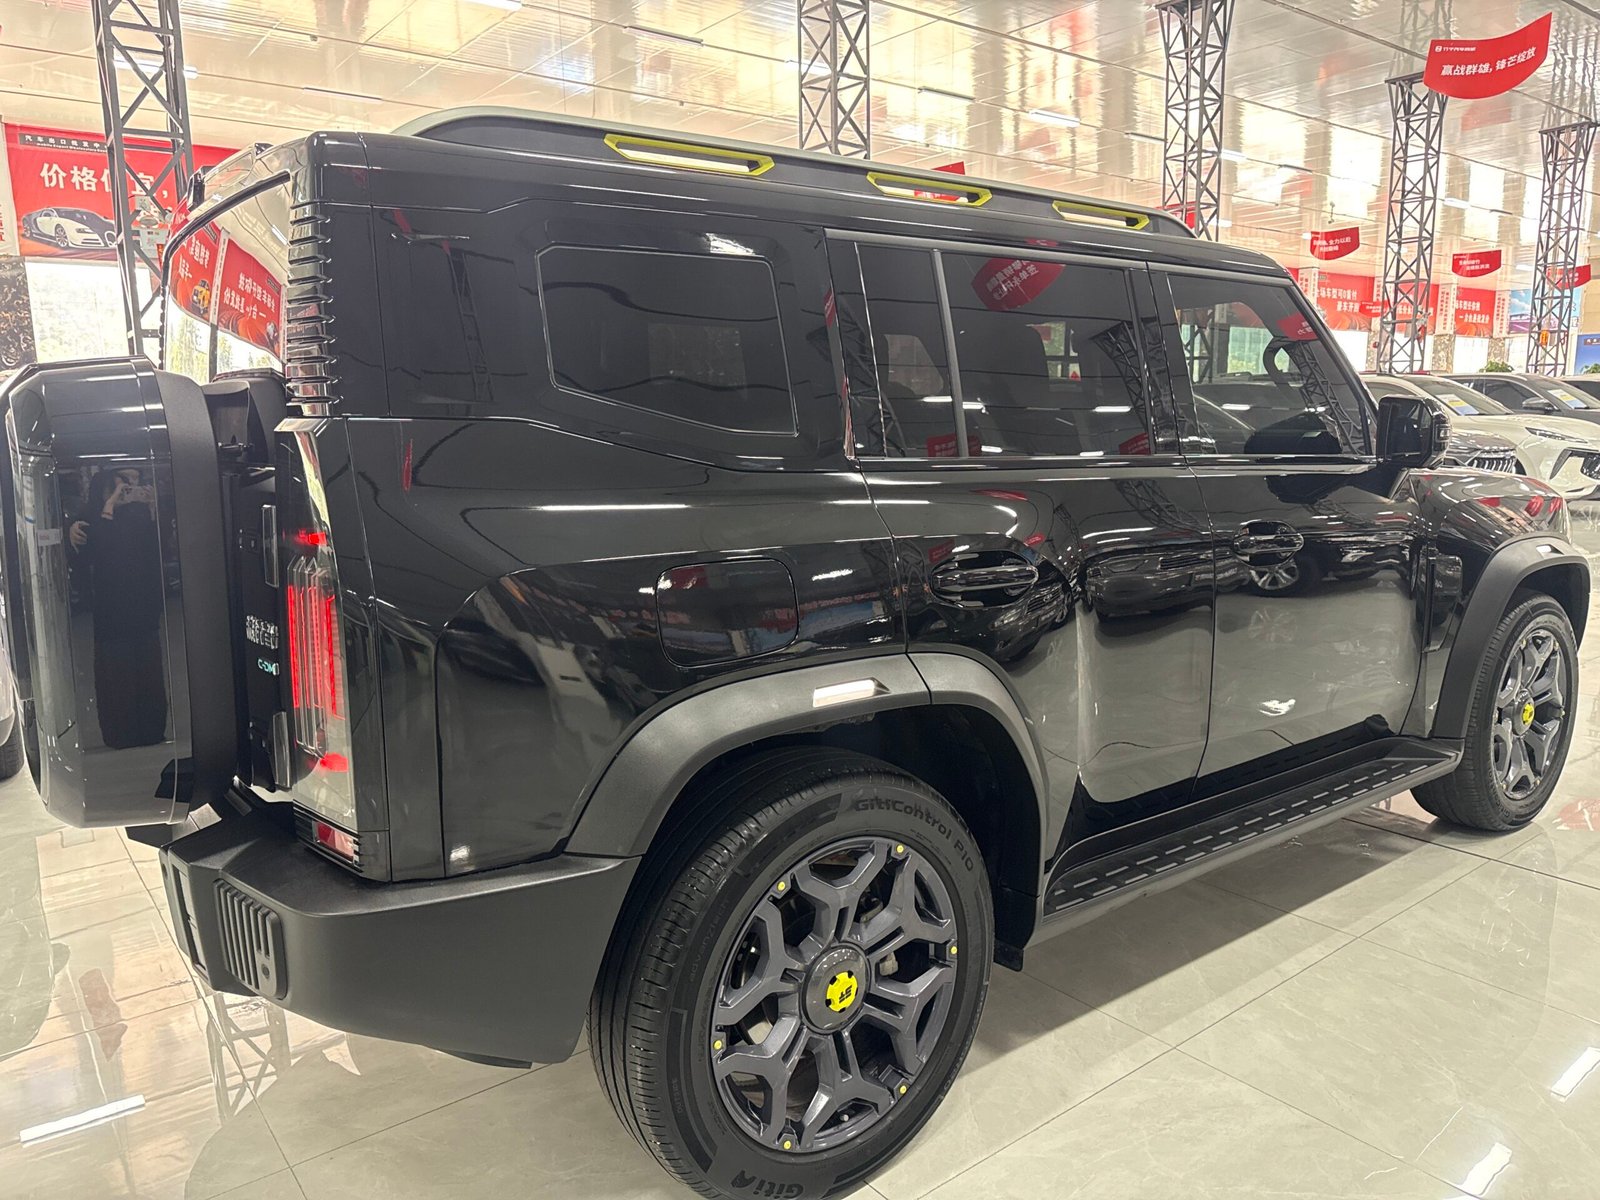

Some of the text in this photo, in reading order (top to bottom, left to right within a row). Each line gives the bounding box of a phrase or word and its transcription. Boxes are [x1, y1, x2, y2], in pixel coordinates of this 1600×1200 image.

[25, 135, 107, 149] 汽车出口批发中
[856, 797, 975, 872] GitiControl P10
